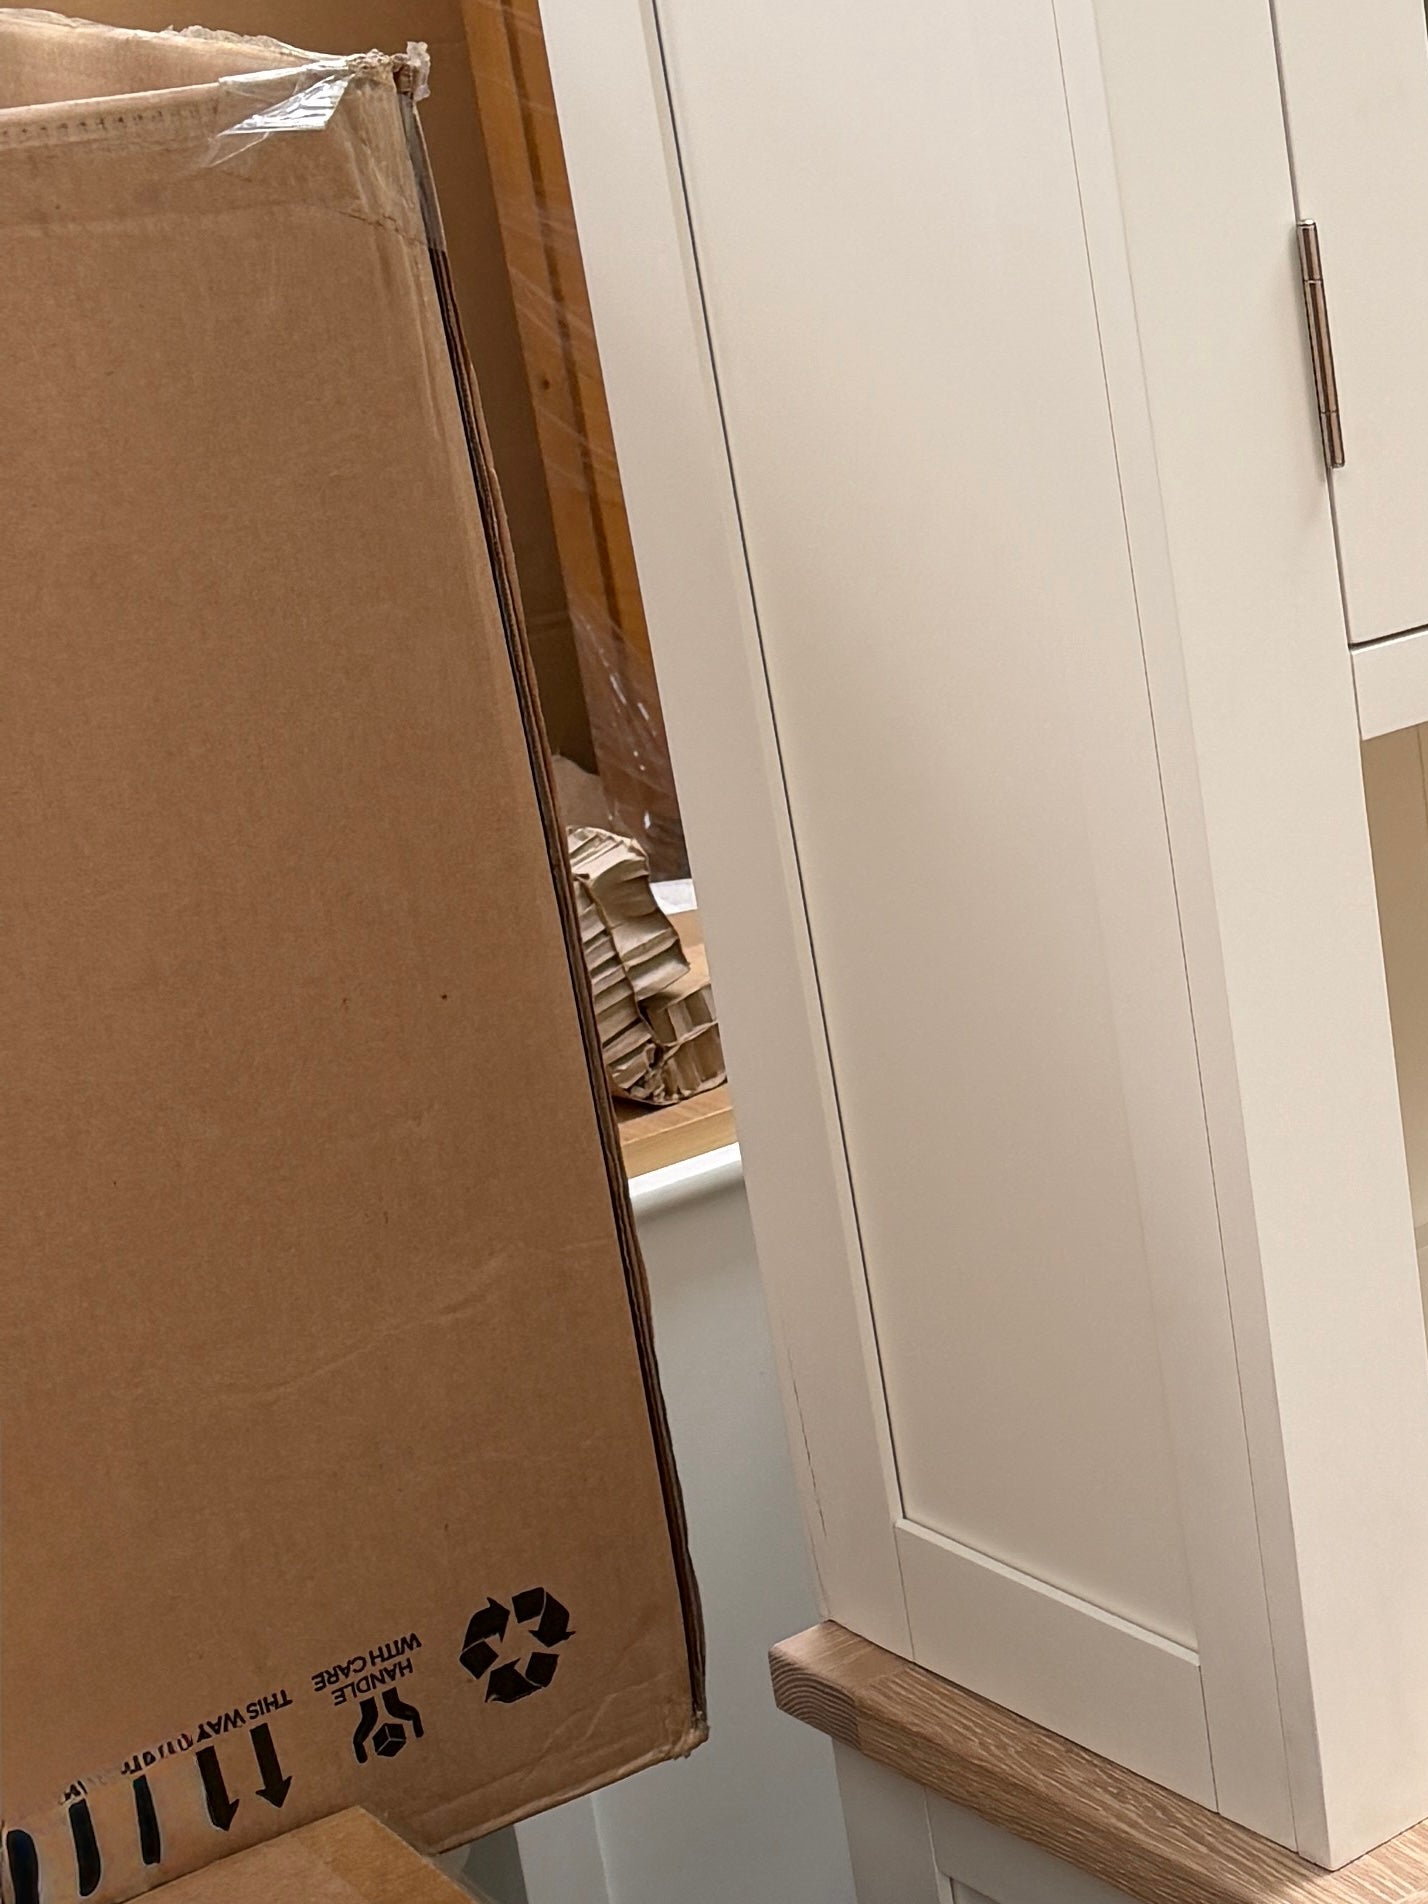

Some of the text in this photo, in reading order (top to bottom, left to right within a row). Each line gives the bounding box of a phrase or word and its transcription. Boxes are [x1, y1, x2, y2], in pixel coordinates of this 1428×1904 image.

[311, 1632, 422, 1693] WITH CARE
[333, 1657, 414, 1706] HANDLE
[196, 1688, 293, 1743] THIS WAY
